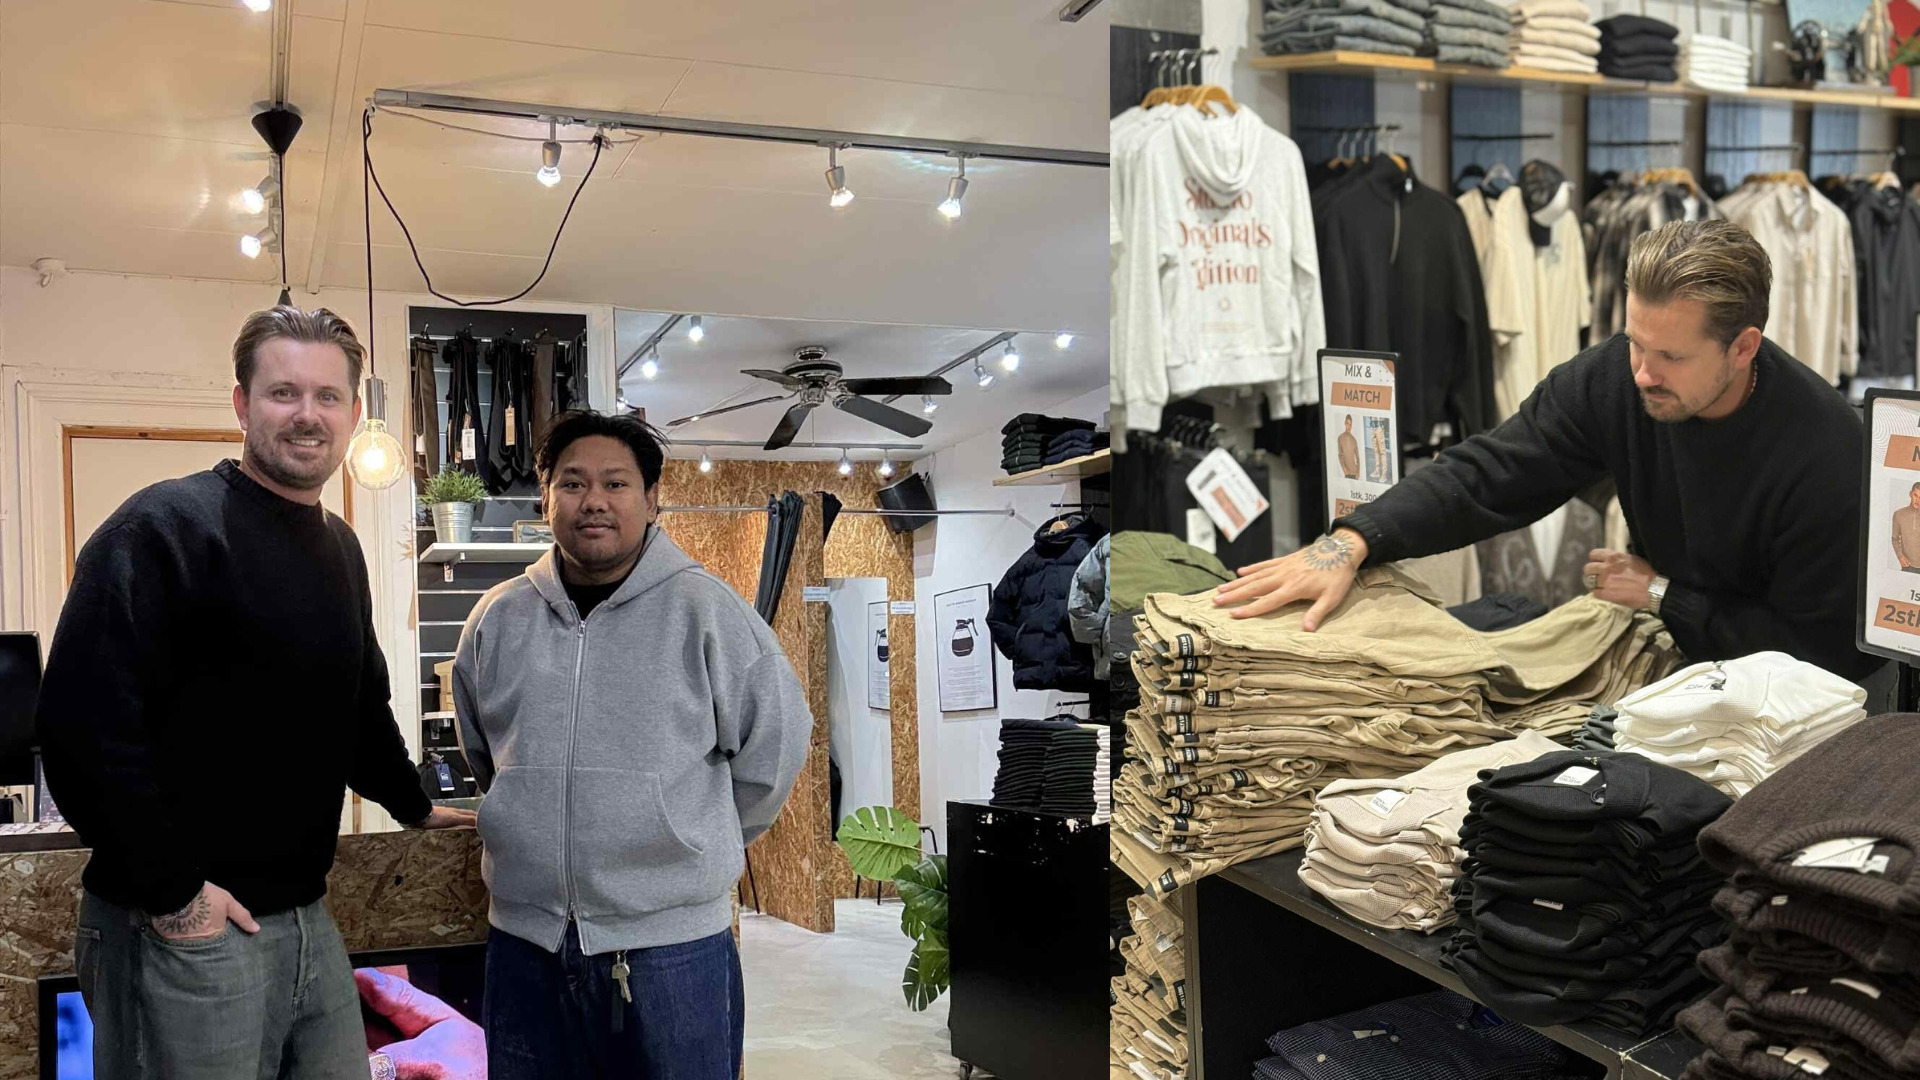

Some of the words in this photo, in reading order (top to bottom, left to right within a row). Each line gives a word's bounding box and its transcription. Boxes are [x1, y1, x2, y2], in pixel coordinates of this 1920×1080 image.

[1345, 364, 1362, 377] MIX
[1365, 366, 1371, 378] &
[1344, 389, 1380, 403] MATCH
